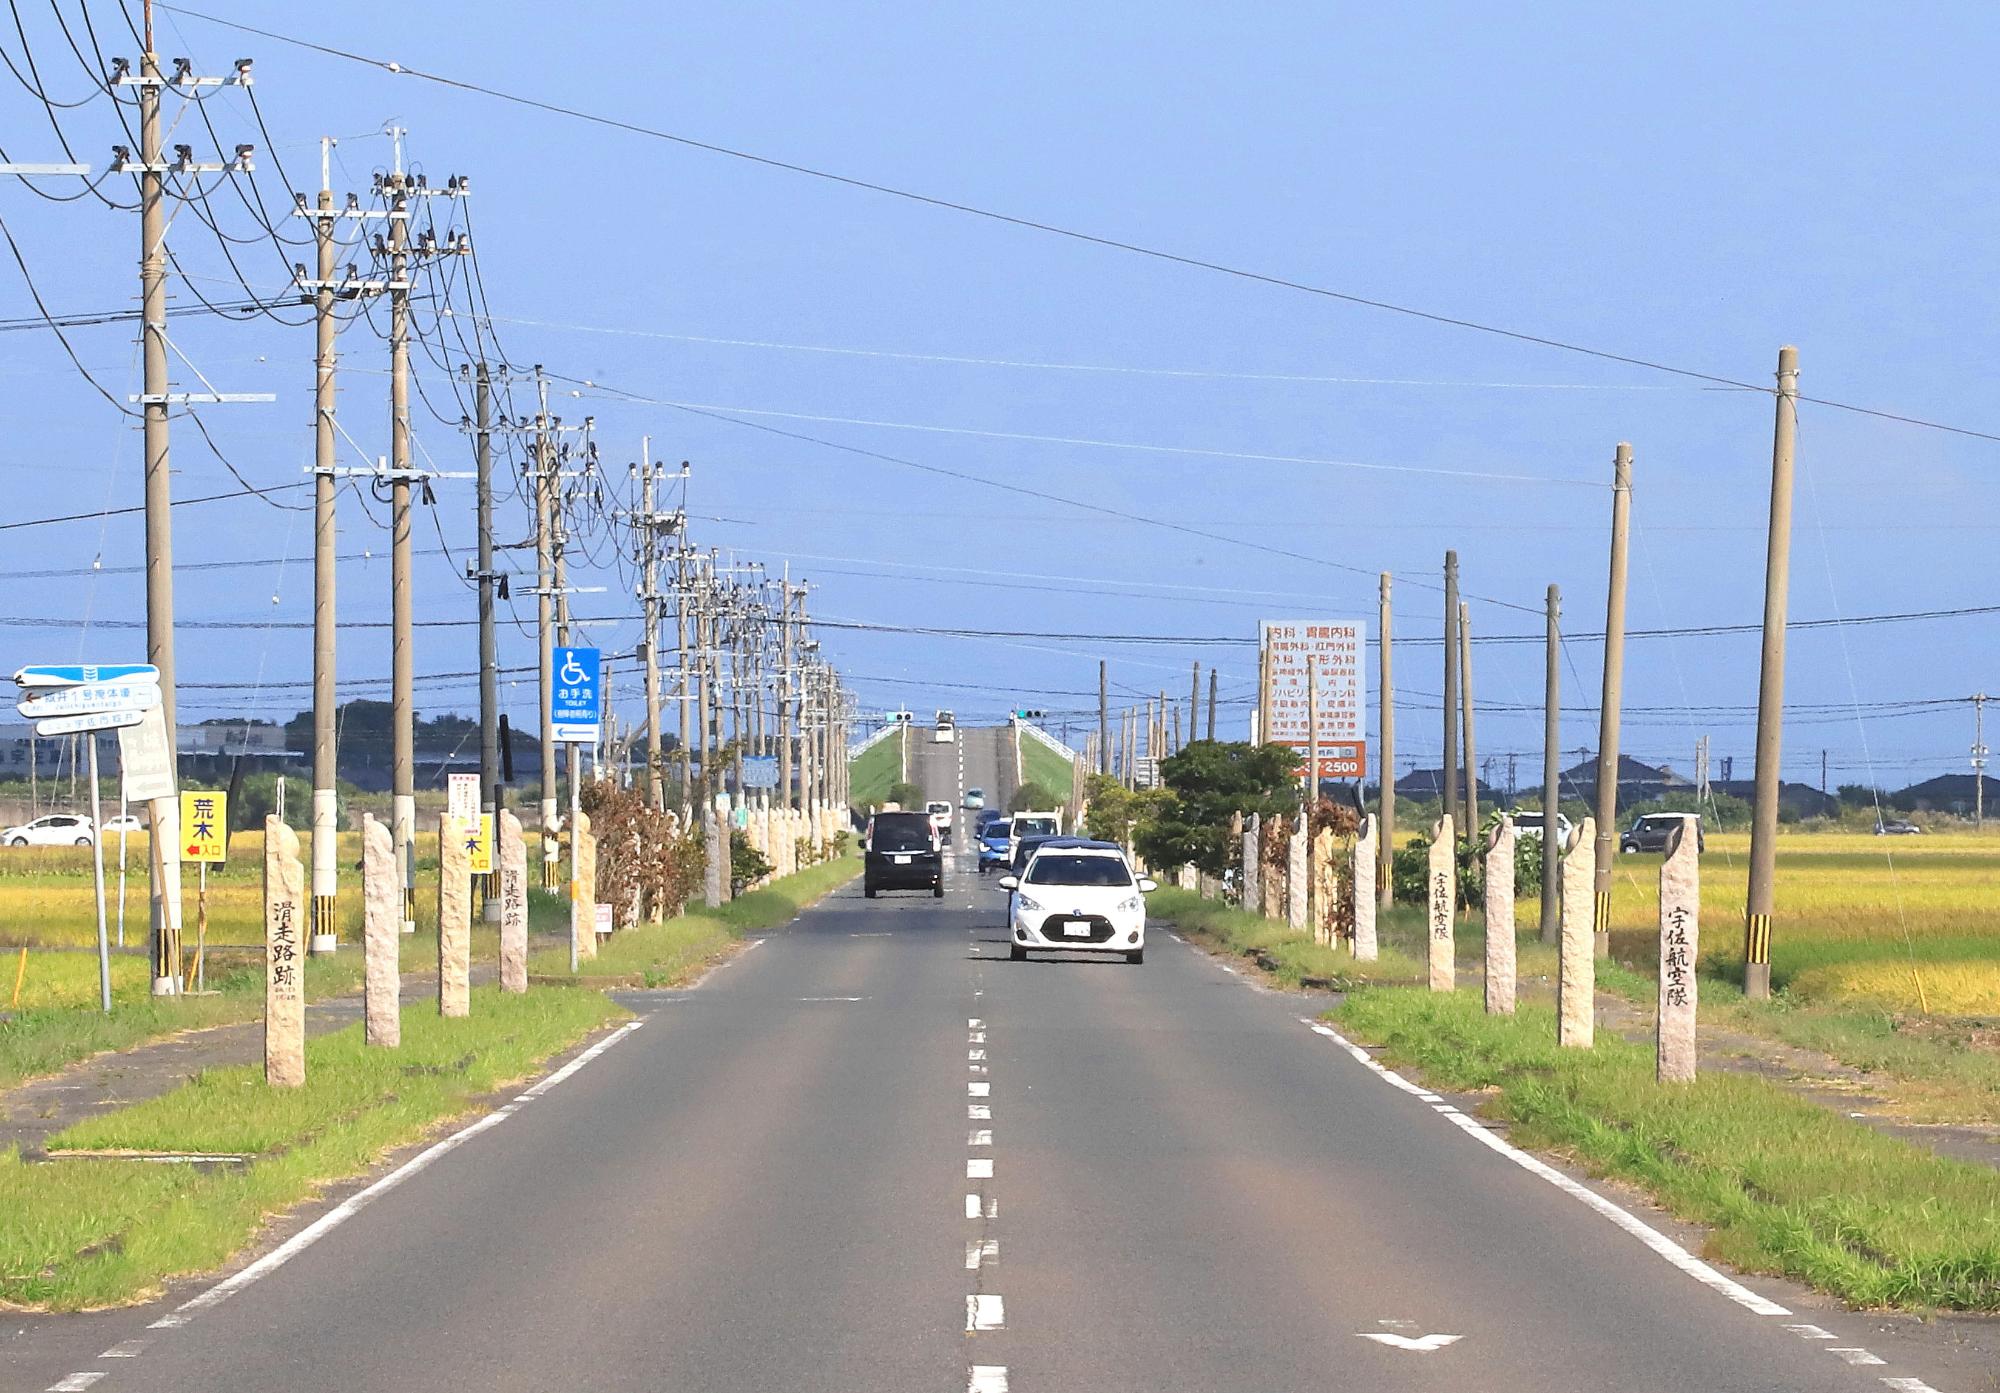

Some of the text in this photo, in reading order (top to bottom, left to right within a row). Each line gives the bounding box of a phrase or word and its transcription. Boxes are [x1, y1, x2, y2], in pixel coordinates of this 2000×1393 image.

[558, 688, 593, 700] お手洗
[193, 798, 214, 841] 荒木
[201, 844, 221, 856] 入口
[470, 859, 489, 869] 入口
[504, 870, 523, 926] 滑走路跡
[1433, 872, 1449, 940] 宇佐航空隊
[273, 900, 297, 986] 滑走路跡
[1665, 906, 1689, 1006] 宇佐航空隊
